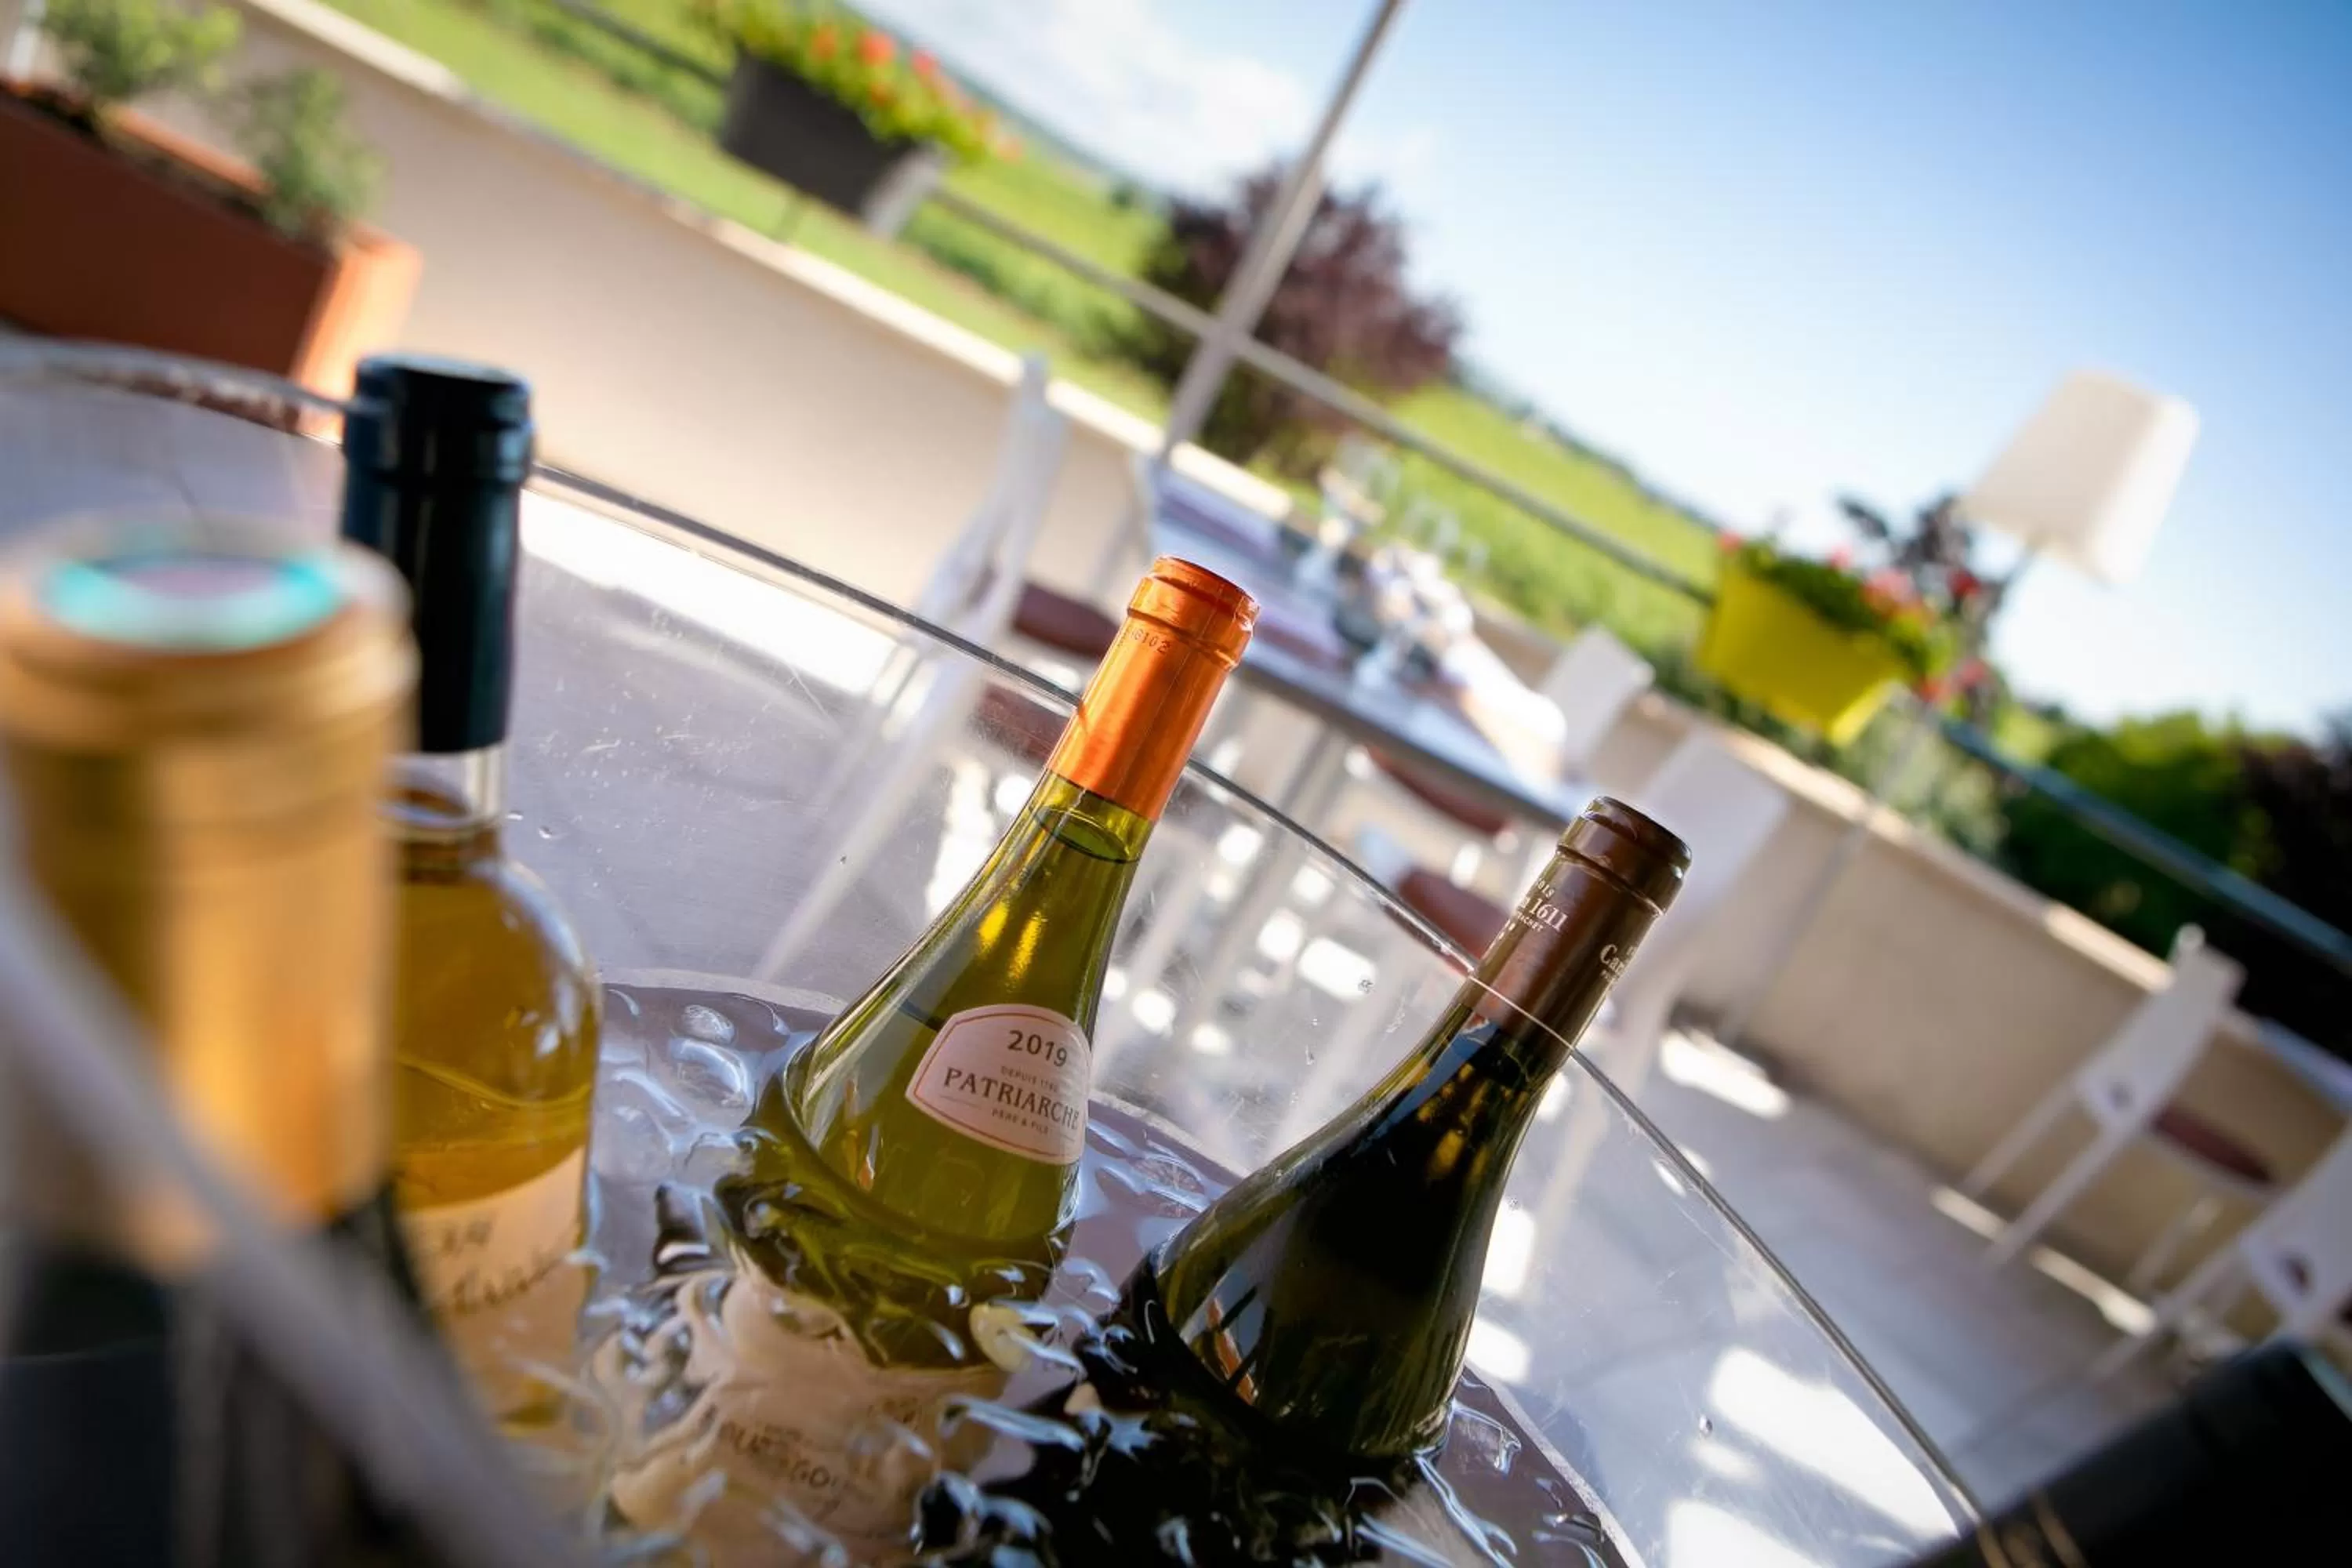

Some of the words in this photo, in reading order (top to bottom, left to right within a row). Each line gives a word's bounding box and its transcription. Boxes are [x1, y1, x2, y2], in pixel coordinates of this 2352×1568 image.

[1529, 898, 1568, 932] 1611
[1007, 1029, 1068, 1067] 2019
[943, 1066, 1080, 1131] PATRIARCHE
